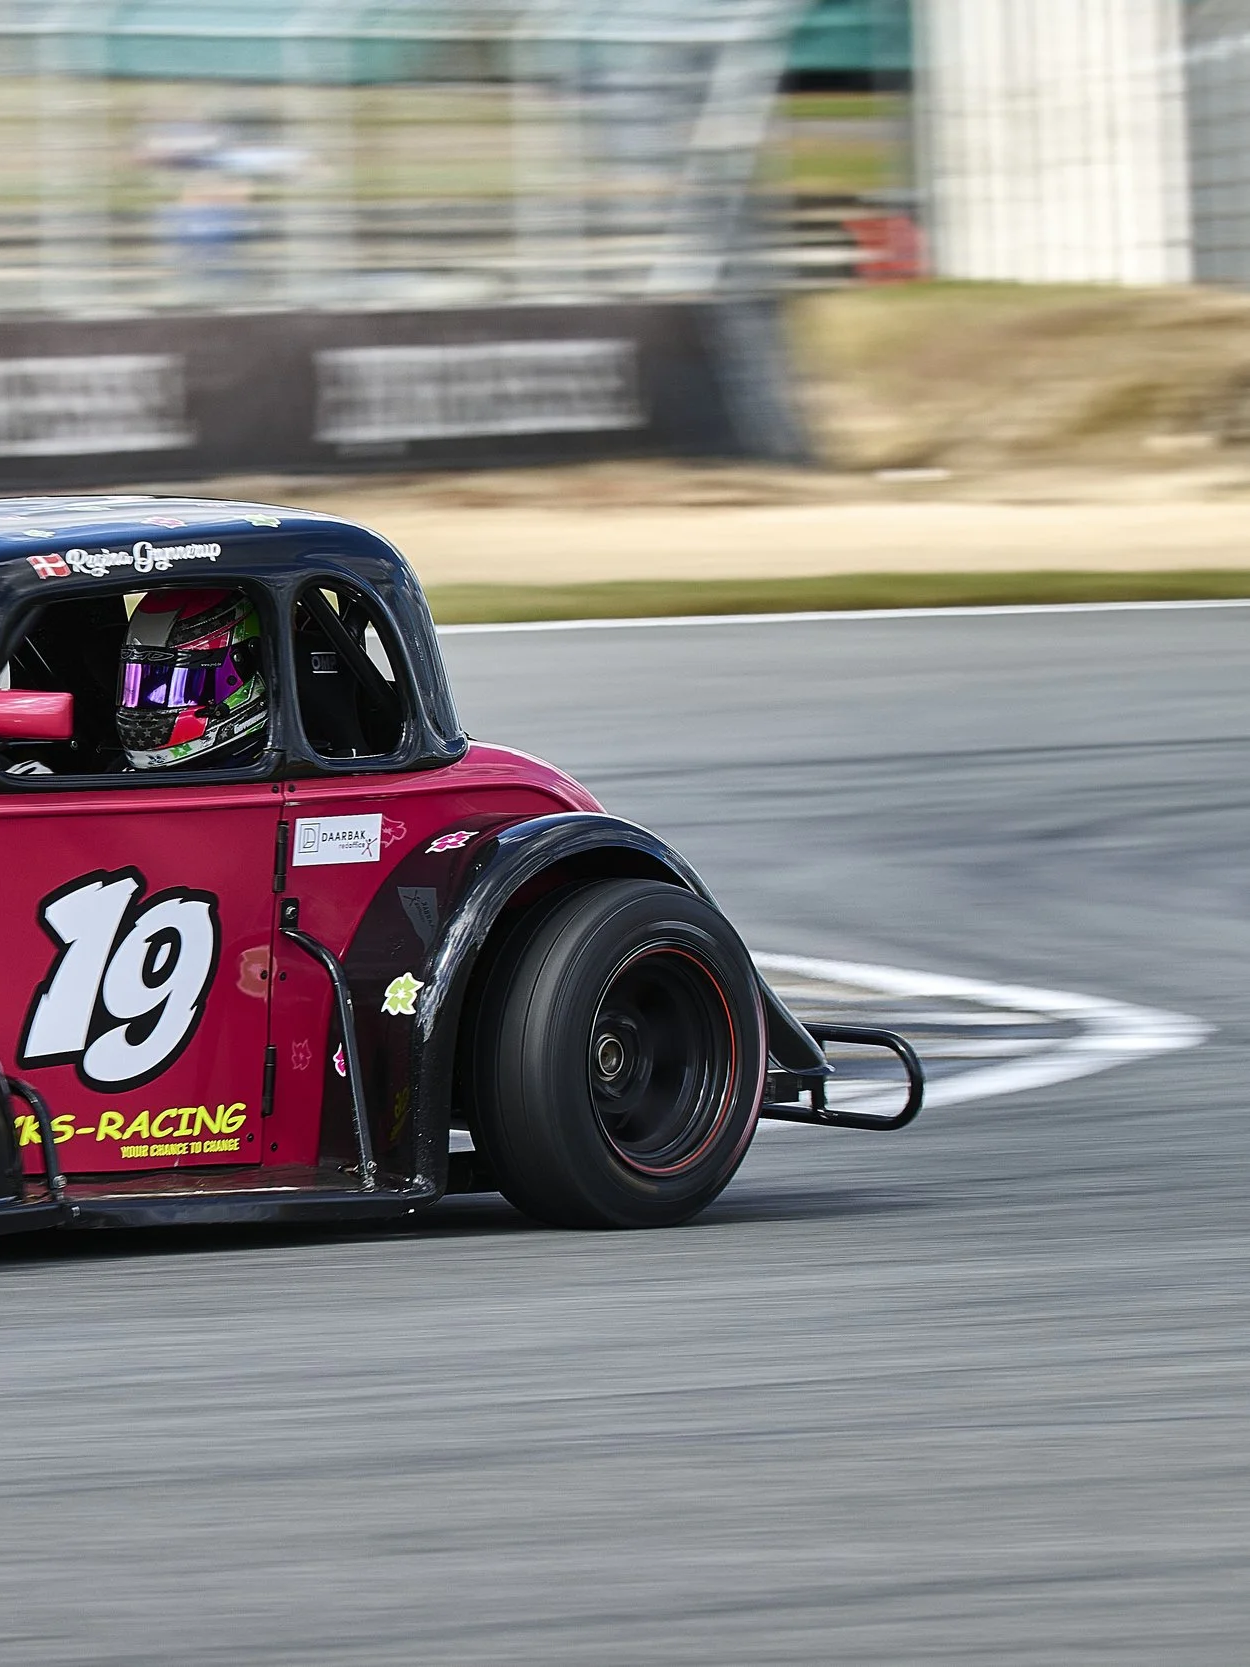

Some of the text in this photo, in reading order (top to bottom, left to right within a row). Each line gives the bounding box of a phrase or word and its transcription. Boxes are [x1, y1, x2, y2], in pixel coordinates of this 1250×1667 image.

[321, 830, 366, 842] DAARBAK
[23, 877, 214, 1082] 19
[120, 1138, 241, 1158] YOUR CHANCE TO CHANGE
